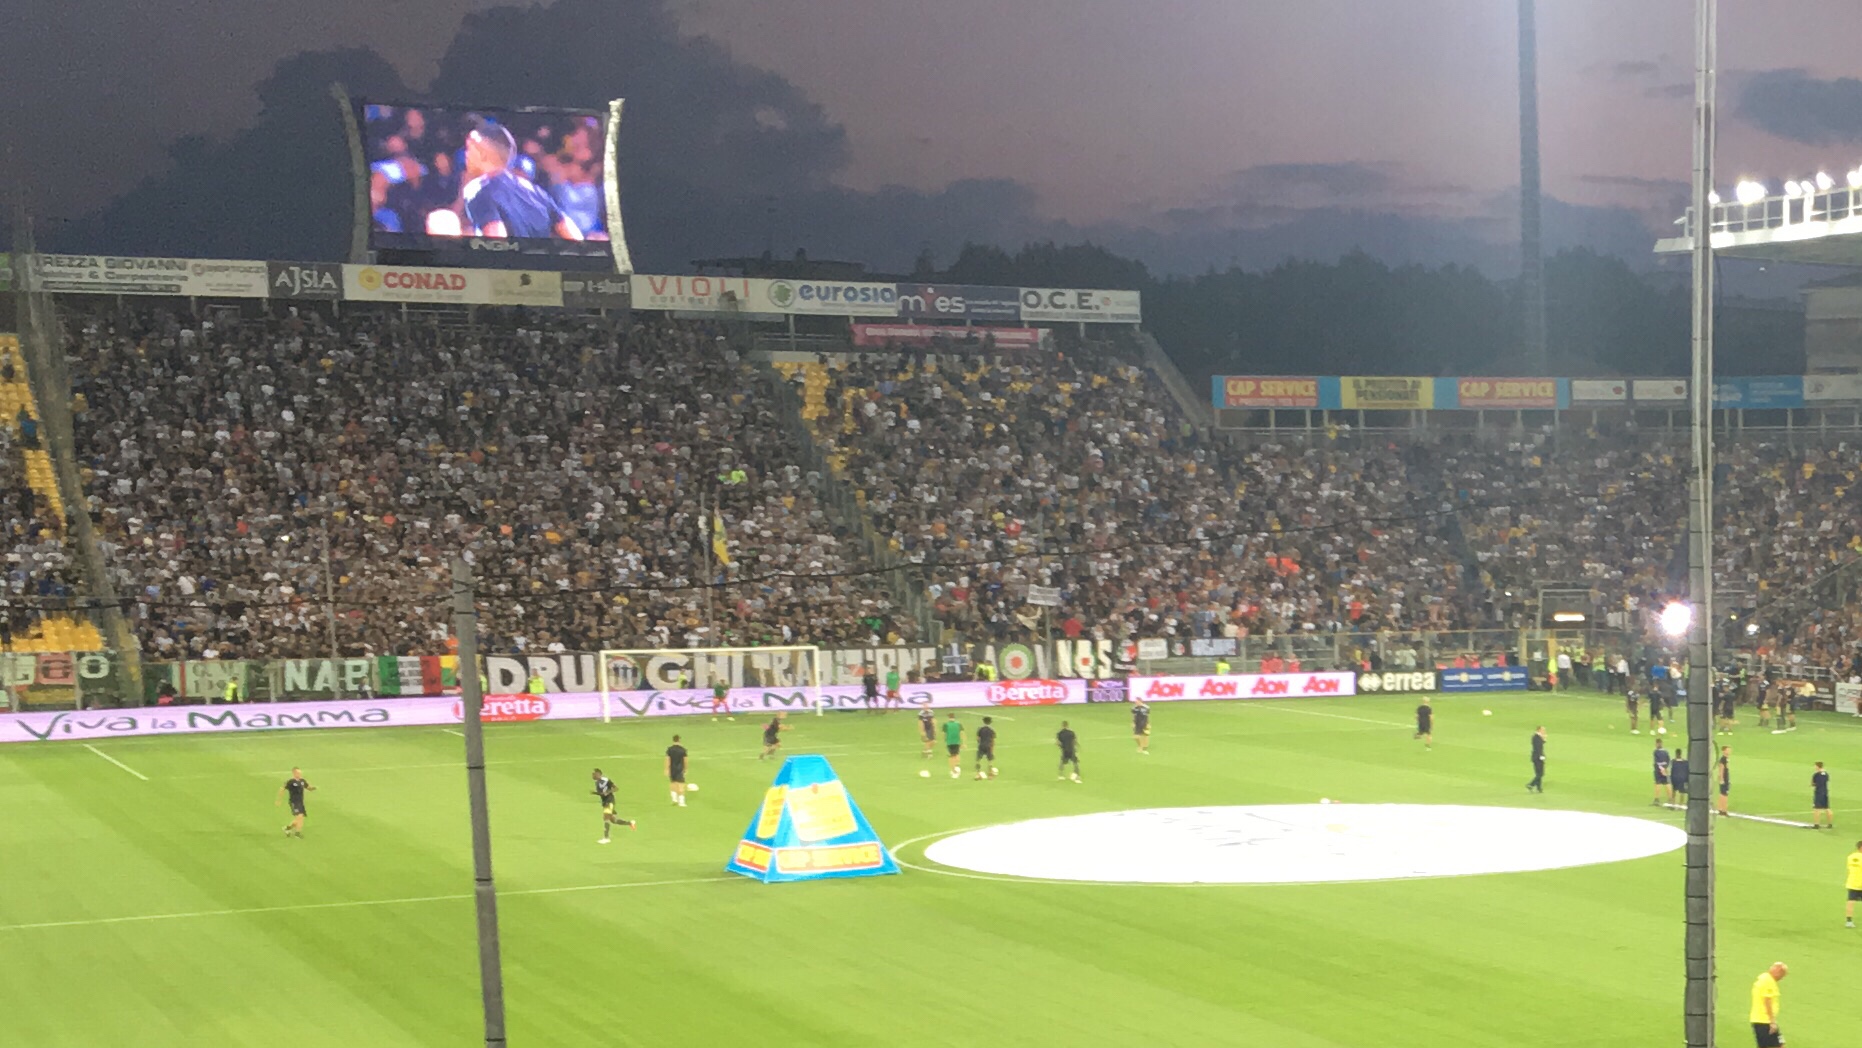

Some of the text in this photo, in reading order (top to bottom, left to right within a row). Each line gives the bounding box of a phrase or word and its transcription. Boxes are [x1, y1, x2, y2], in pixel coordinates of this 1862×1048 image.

[383, 272, 467, 290] CONAD
[798, 283, 896, 303] eurosia
[1226, 380, 1317, 397] CAP SERVICE
[1460, 381, 1554, 397] CAP SERVICE
[990, 684, 1064, 701] Beretta
[468, 698, 547, 716] eretta
[16, 708, 391, 740] Viva la Mamma
